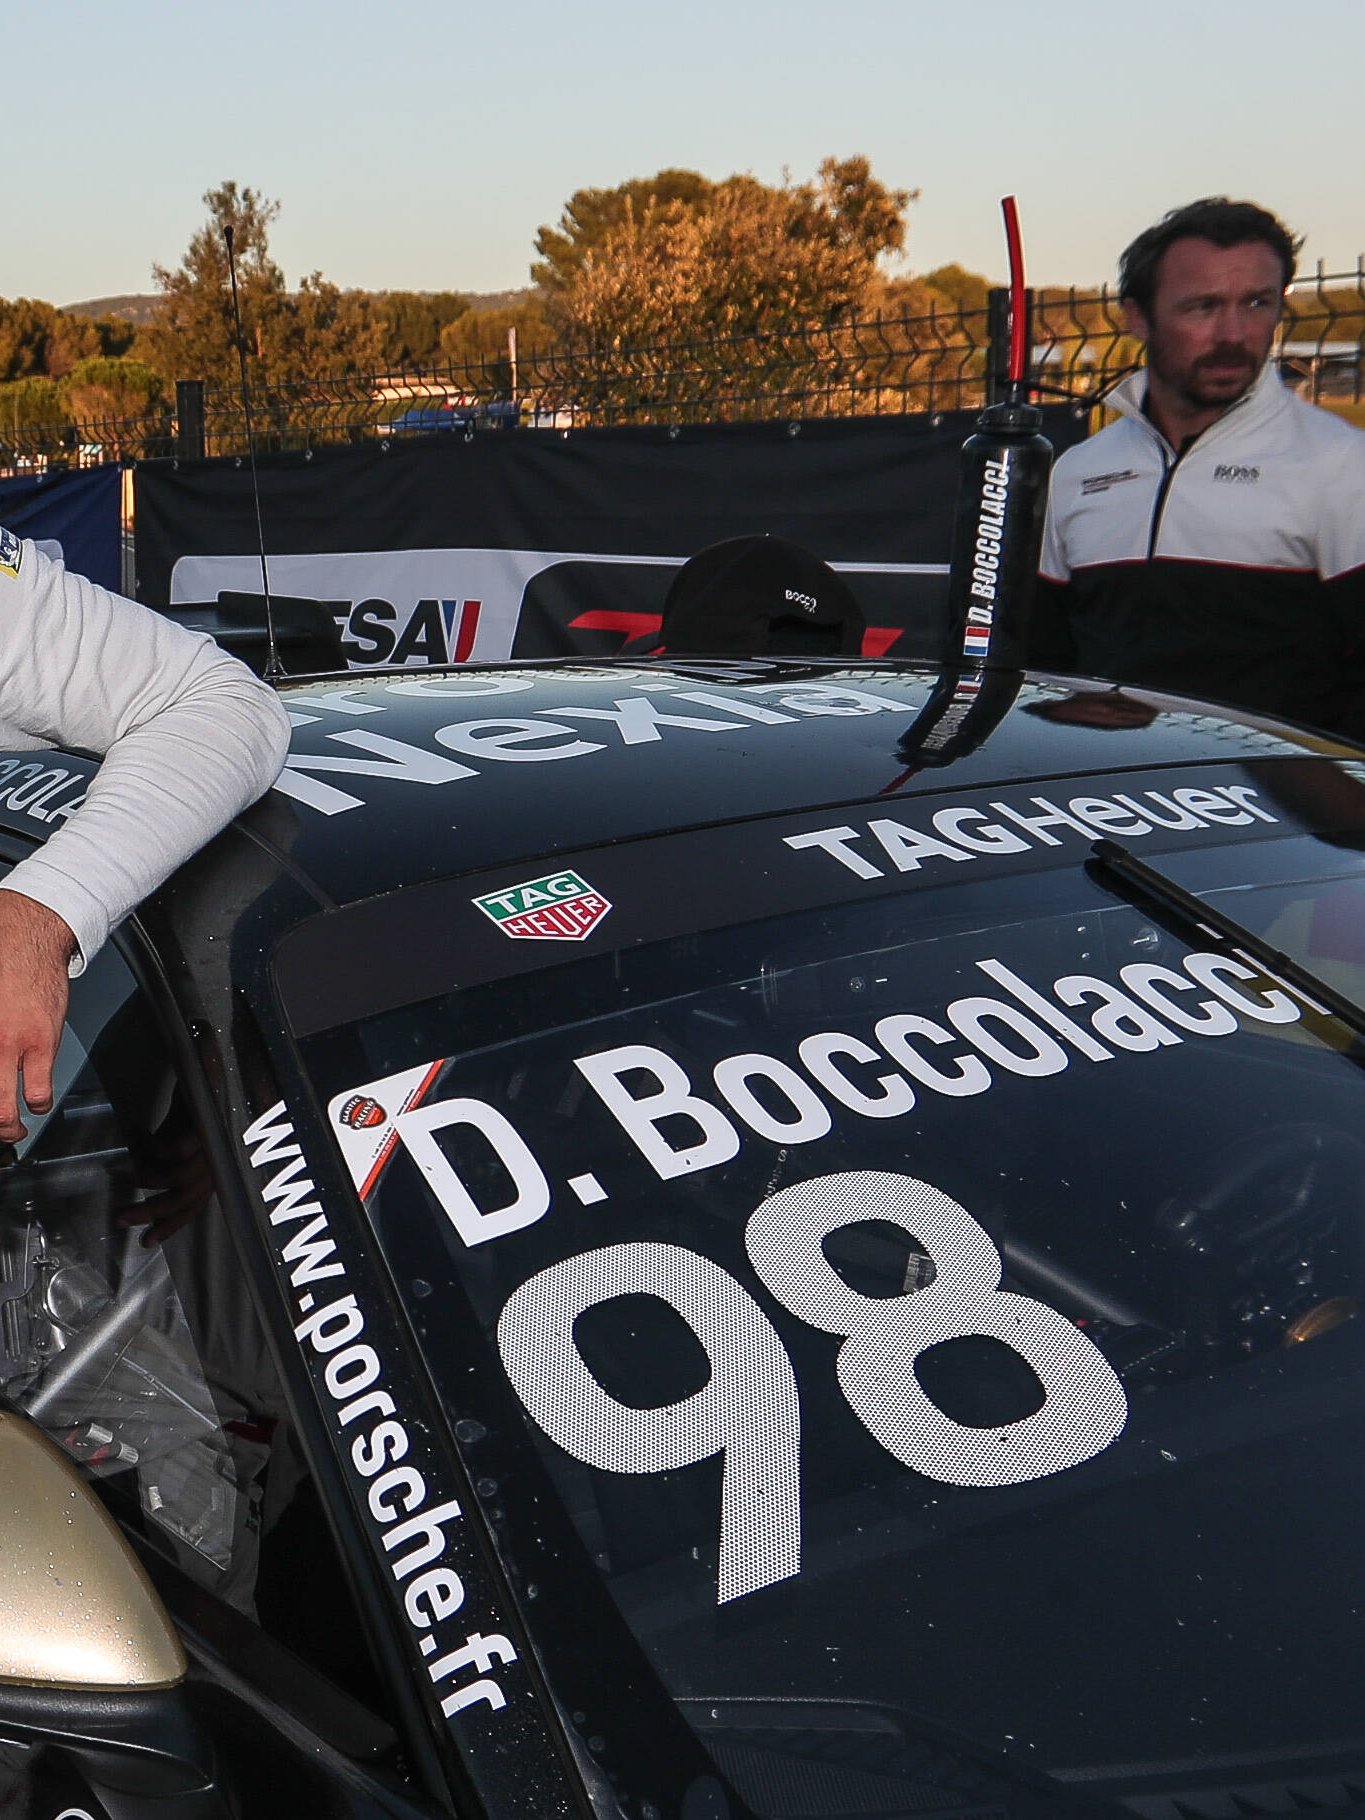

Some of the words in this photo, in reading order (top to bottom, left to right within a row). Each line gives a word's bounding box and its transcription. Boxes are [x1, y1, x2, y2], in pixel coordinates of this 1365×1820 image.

[971, 458, 1011, 598] BOCCOLACCI
[966, 605, 993, 625] D.
[486, 877, 582, 913] TAG
[507, 896, 603, 935] HEUER
[397, 1096, 608, 1248] D.
[242, 1100, 518, 1719] www.porsche.fr
[497, 1170, 1129, 1604] 98
